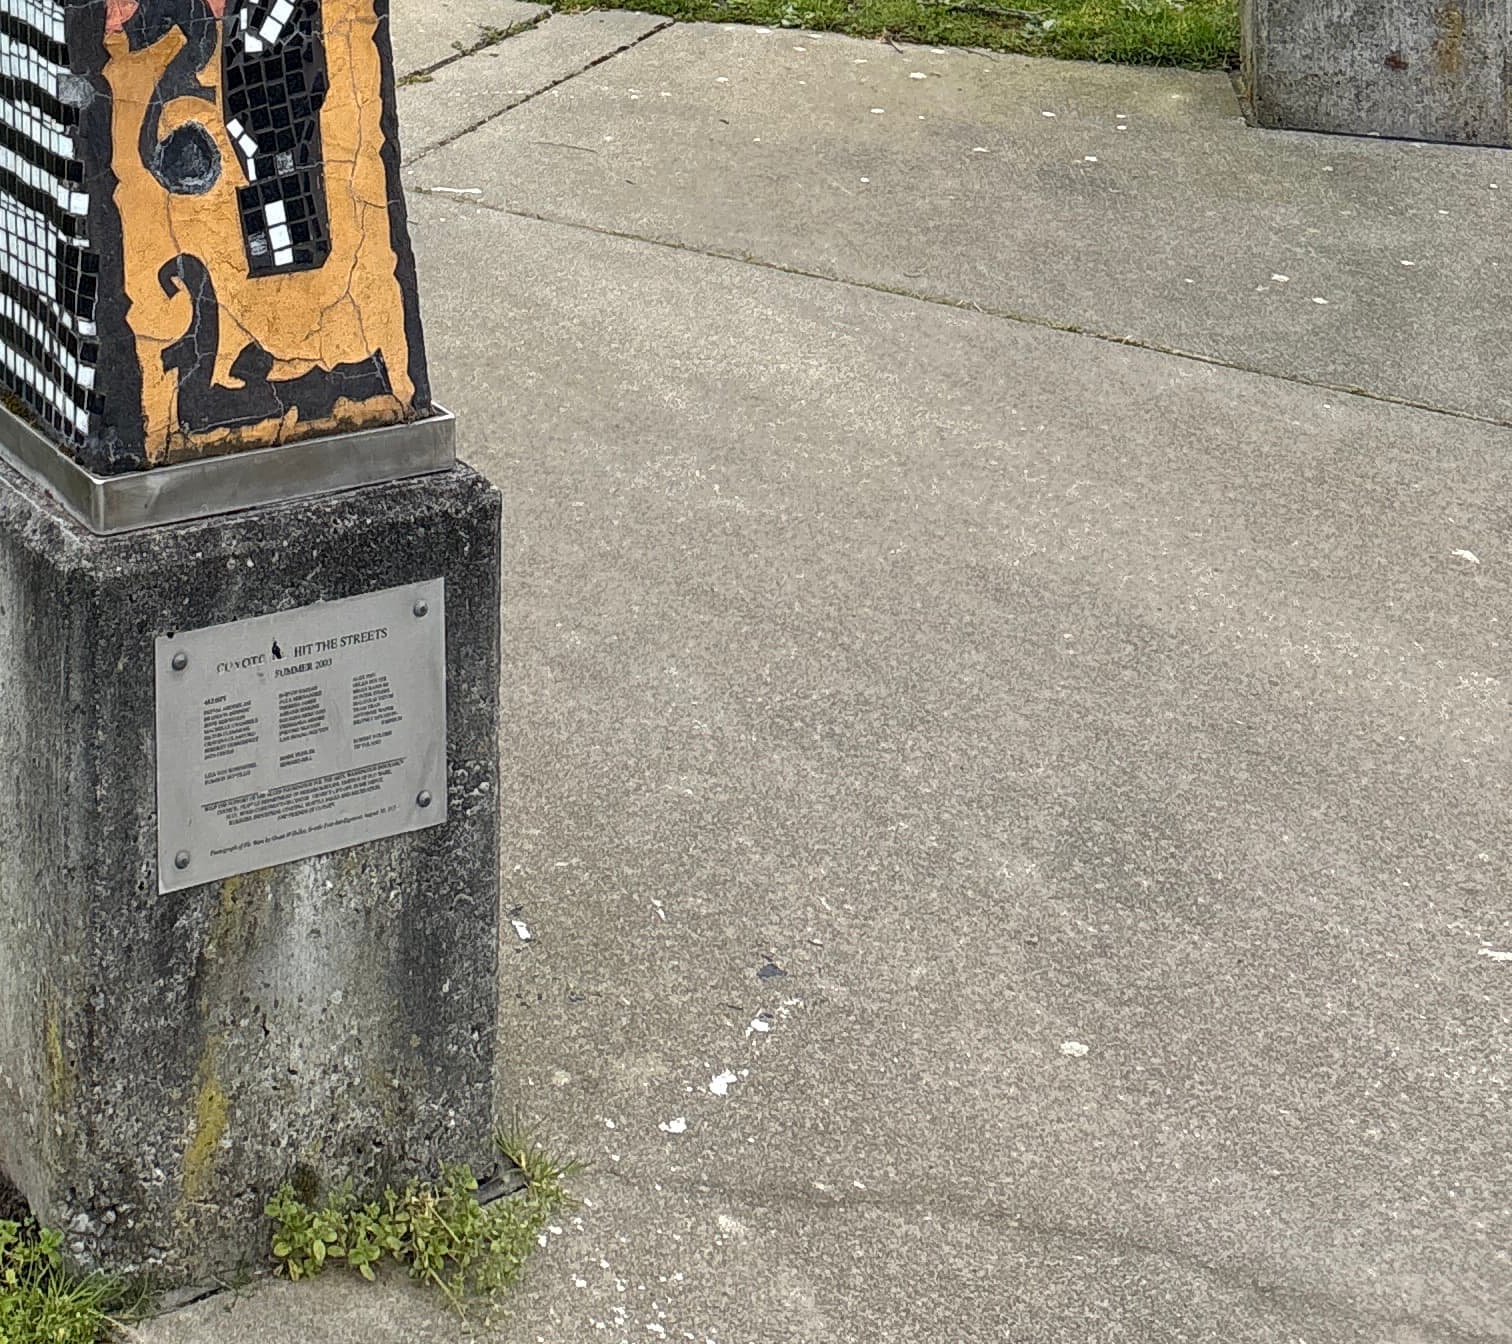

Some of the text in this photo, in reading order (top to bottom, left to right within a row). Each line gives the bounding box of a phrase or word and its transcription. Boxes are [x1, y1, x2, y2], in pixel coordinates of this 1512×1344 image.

[293, 642, 313, 658] HIT
[315, 637, 338, 653] THE
[339, 627, 389, 649] STREETS
[274, 661, 314, 679] SUMMER
